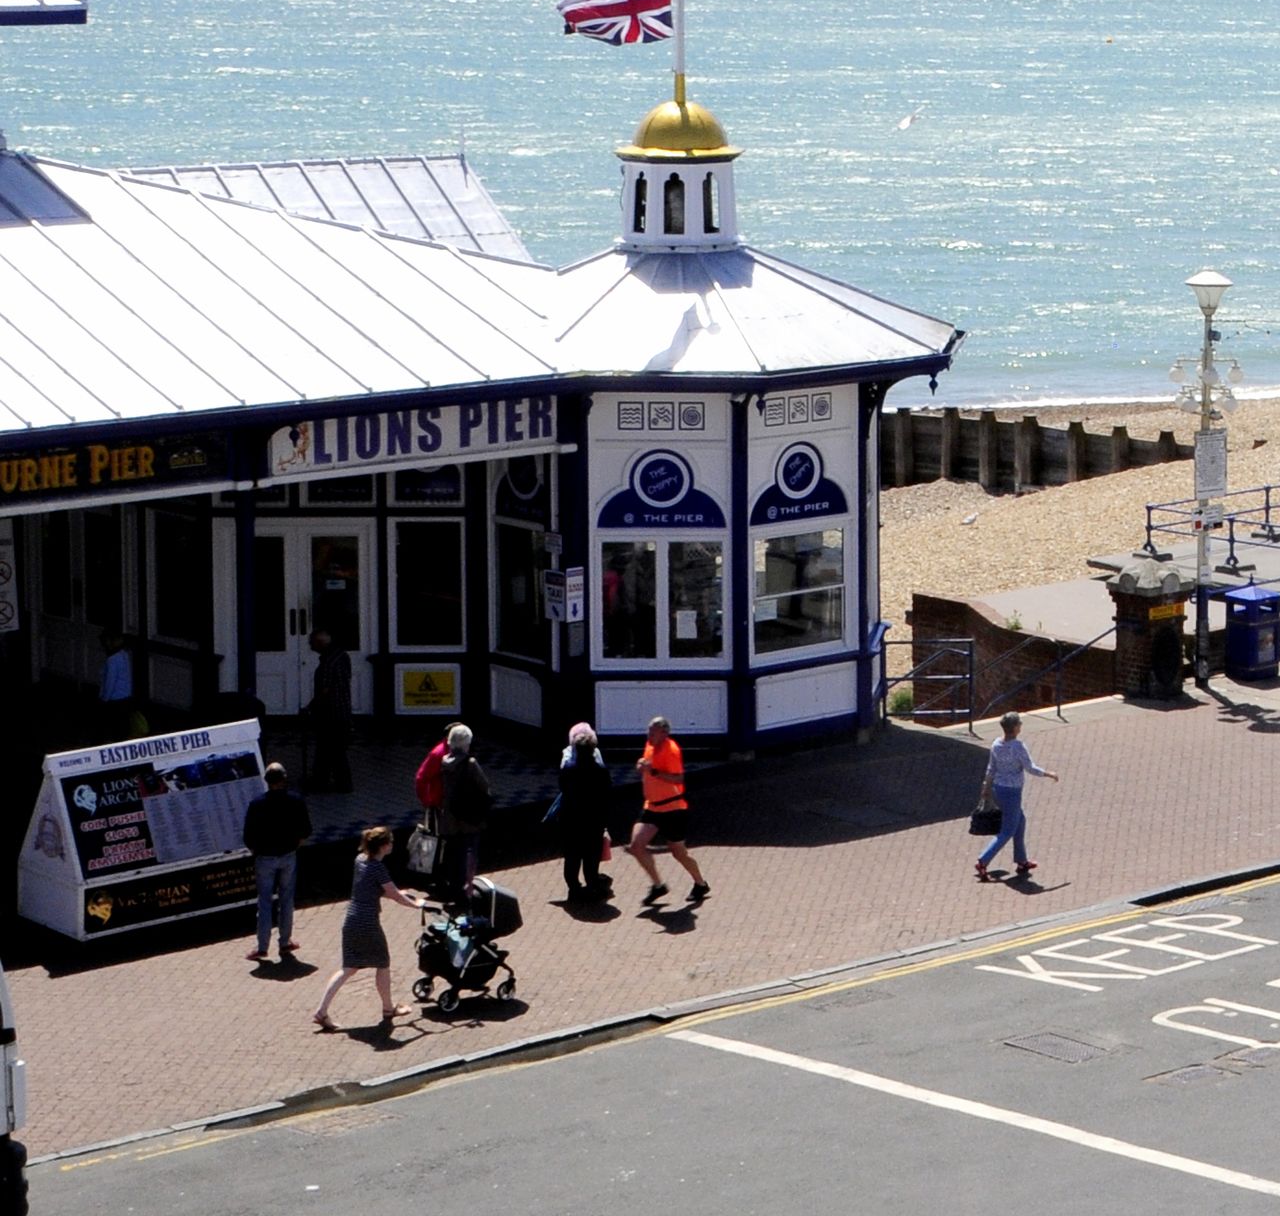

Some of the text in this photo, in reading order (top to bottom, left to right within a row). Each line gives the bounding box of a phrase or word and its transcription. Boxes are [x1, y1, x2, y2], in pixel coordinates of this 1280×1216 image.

[313, 395, 552, 465] LIONS PIER
[649, 466, 668, 478] THE
[643, 514, 669, 522] THE
[674, 514, 704, 522] PIER
[780, 505, 801, 515] THE
[804, 501, 830, 512] PIER
[100, 731, 211, 766] EASTBOURNE PIER
[975, 913, 1280, 992] KEEP
